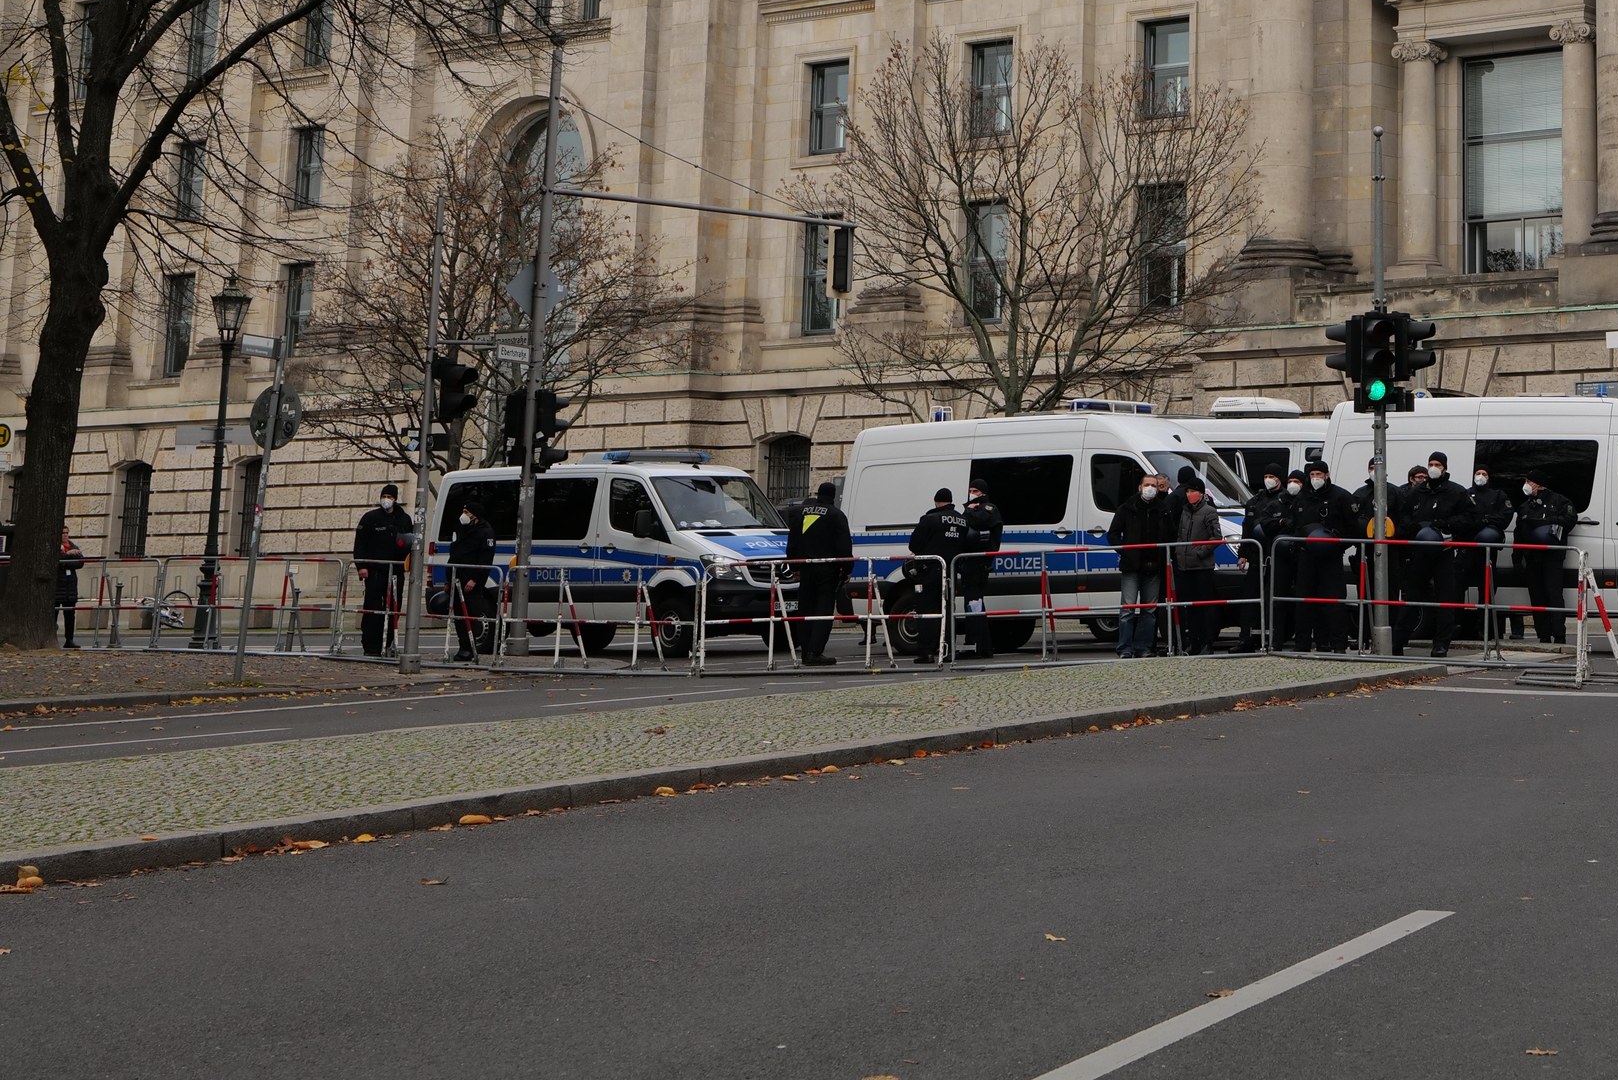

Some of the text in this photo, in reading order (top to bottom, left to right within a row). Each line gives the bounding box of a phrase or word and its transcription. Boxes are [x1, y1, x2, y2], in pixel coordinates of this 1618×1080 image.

[501, 347, 527, 360] Ebertstraße
[802, 506, 828, 515] POLIZEI
[941, 515, 967, 527] POLIZEI
[995, 557, 1047, 570] POLIZE
[536, 569, 571, 580] POLIZEI
